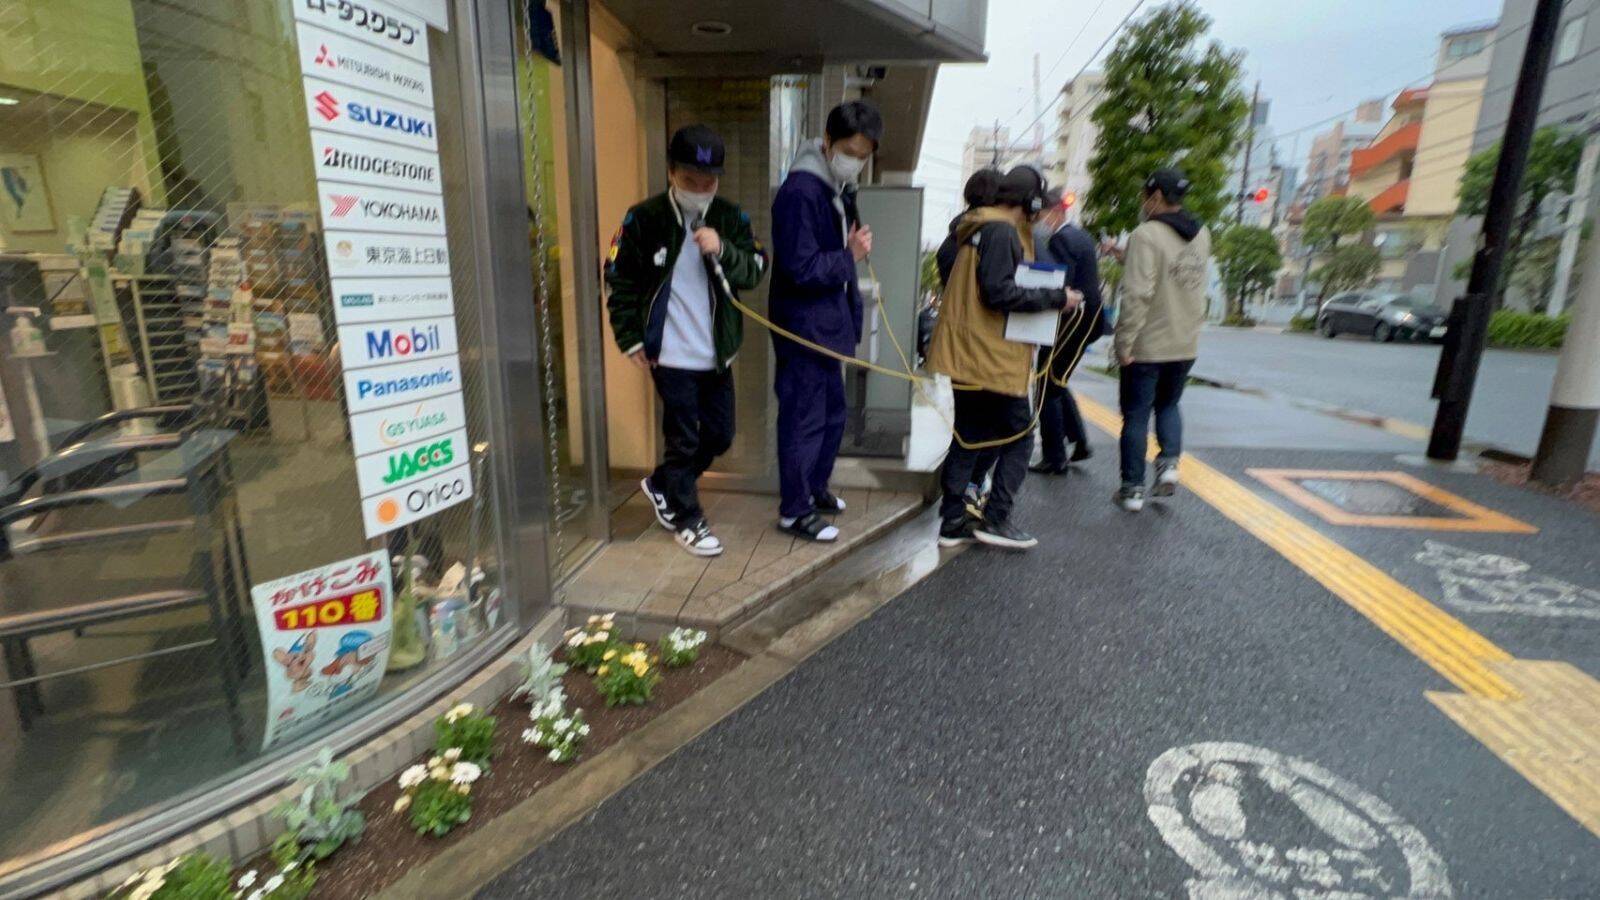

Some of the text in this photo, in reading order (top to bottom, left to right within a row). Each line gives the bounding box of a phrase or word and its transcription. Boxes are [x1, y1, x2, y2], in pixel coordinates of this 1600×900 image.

[307, 0, 420, 45] ロータスクラブ
[336, 55, 391, 81] MITSUBISHI
[347, 102, 432, 138] SUZUKI
[323, 146, 435, 182] BRIDGESTONE
[360, 198, 440, 223] YOKOHAMA
[366, 246, 447, 265] 東京海上日動
[366, 325, 440, 359] Mobil
[357, 367, 453, 400] Panasonic
[386, 411, 447, 438] GS YUASA
[383, 438, 454, 485] JACCS
[406, 478, 464, 513] Orico
[270, 558, 382, 606] かけこみ
[282, 590, 380, 628] 110番
